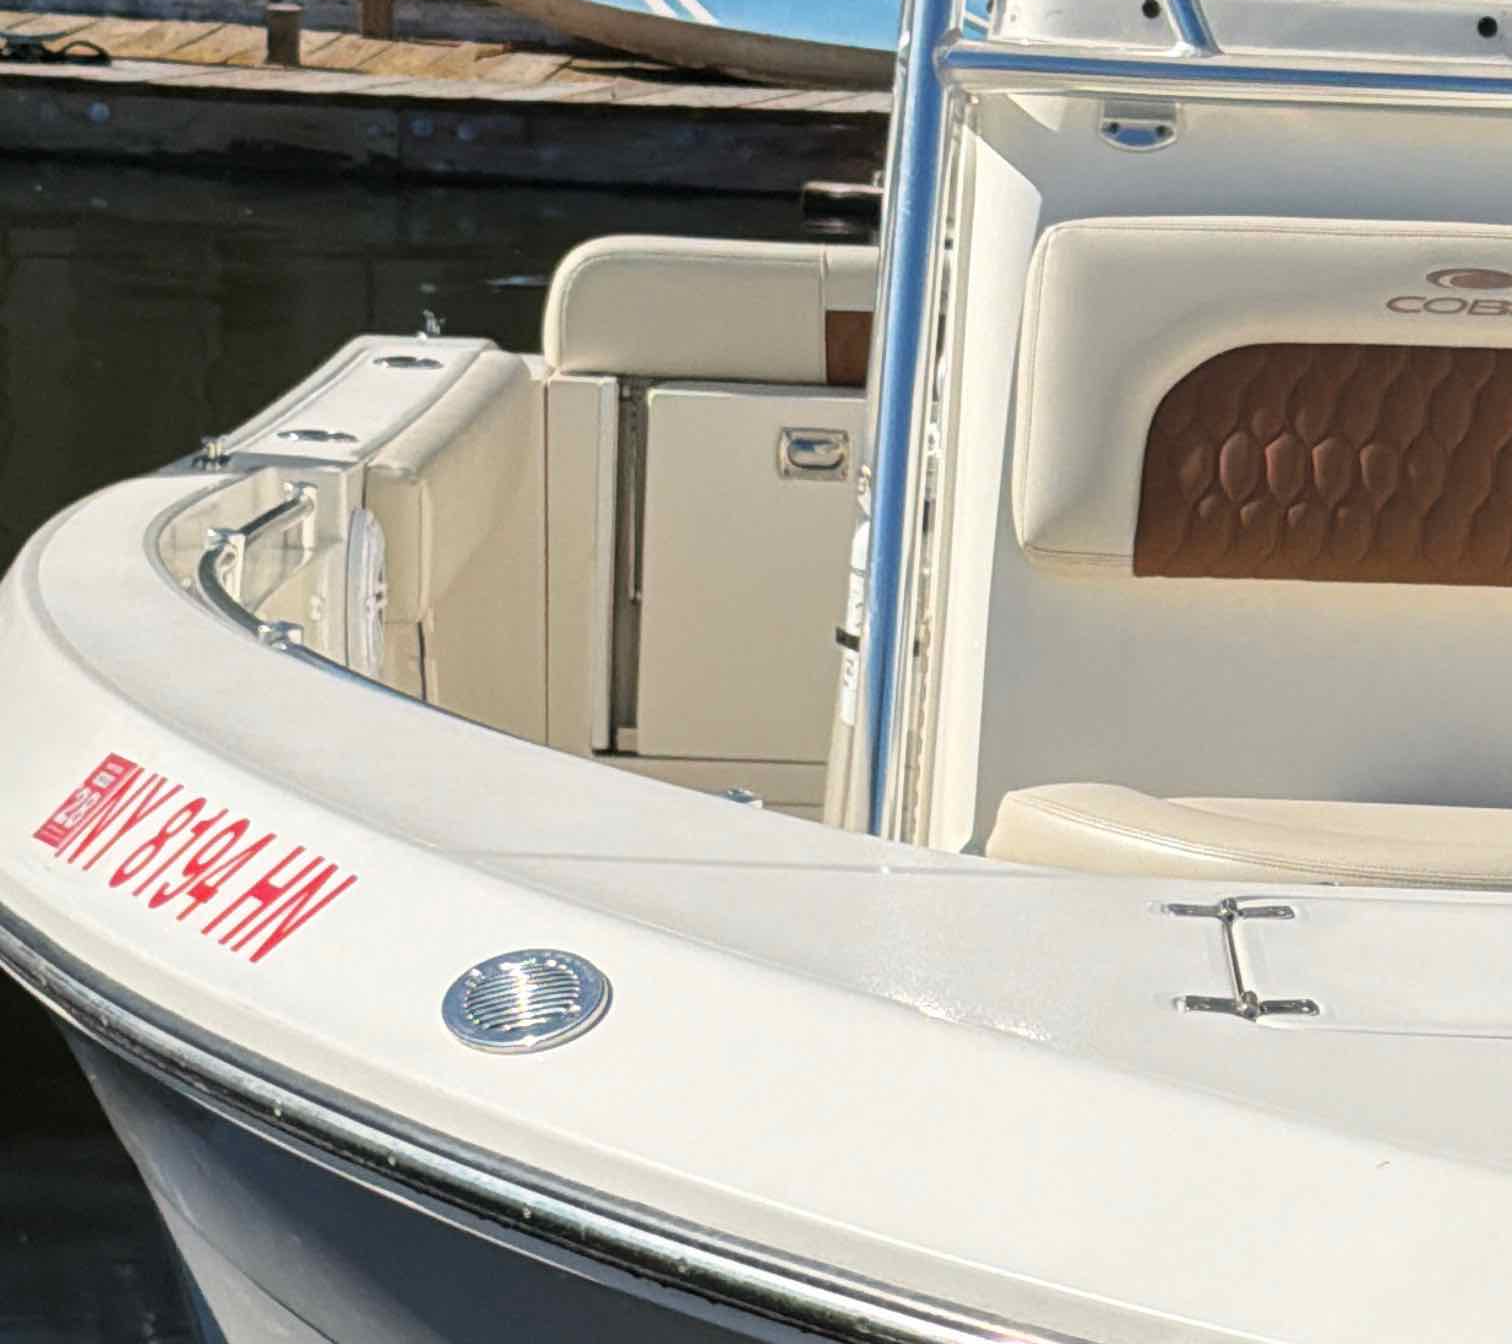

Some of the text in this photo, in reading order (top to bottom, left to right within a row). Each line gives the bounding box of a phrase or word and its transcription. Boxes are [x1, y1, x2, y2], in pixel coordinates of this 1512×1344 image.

[54, 767, 358, 963] NY 8194 HN
